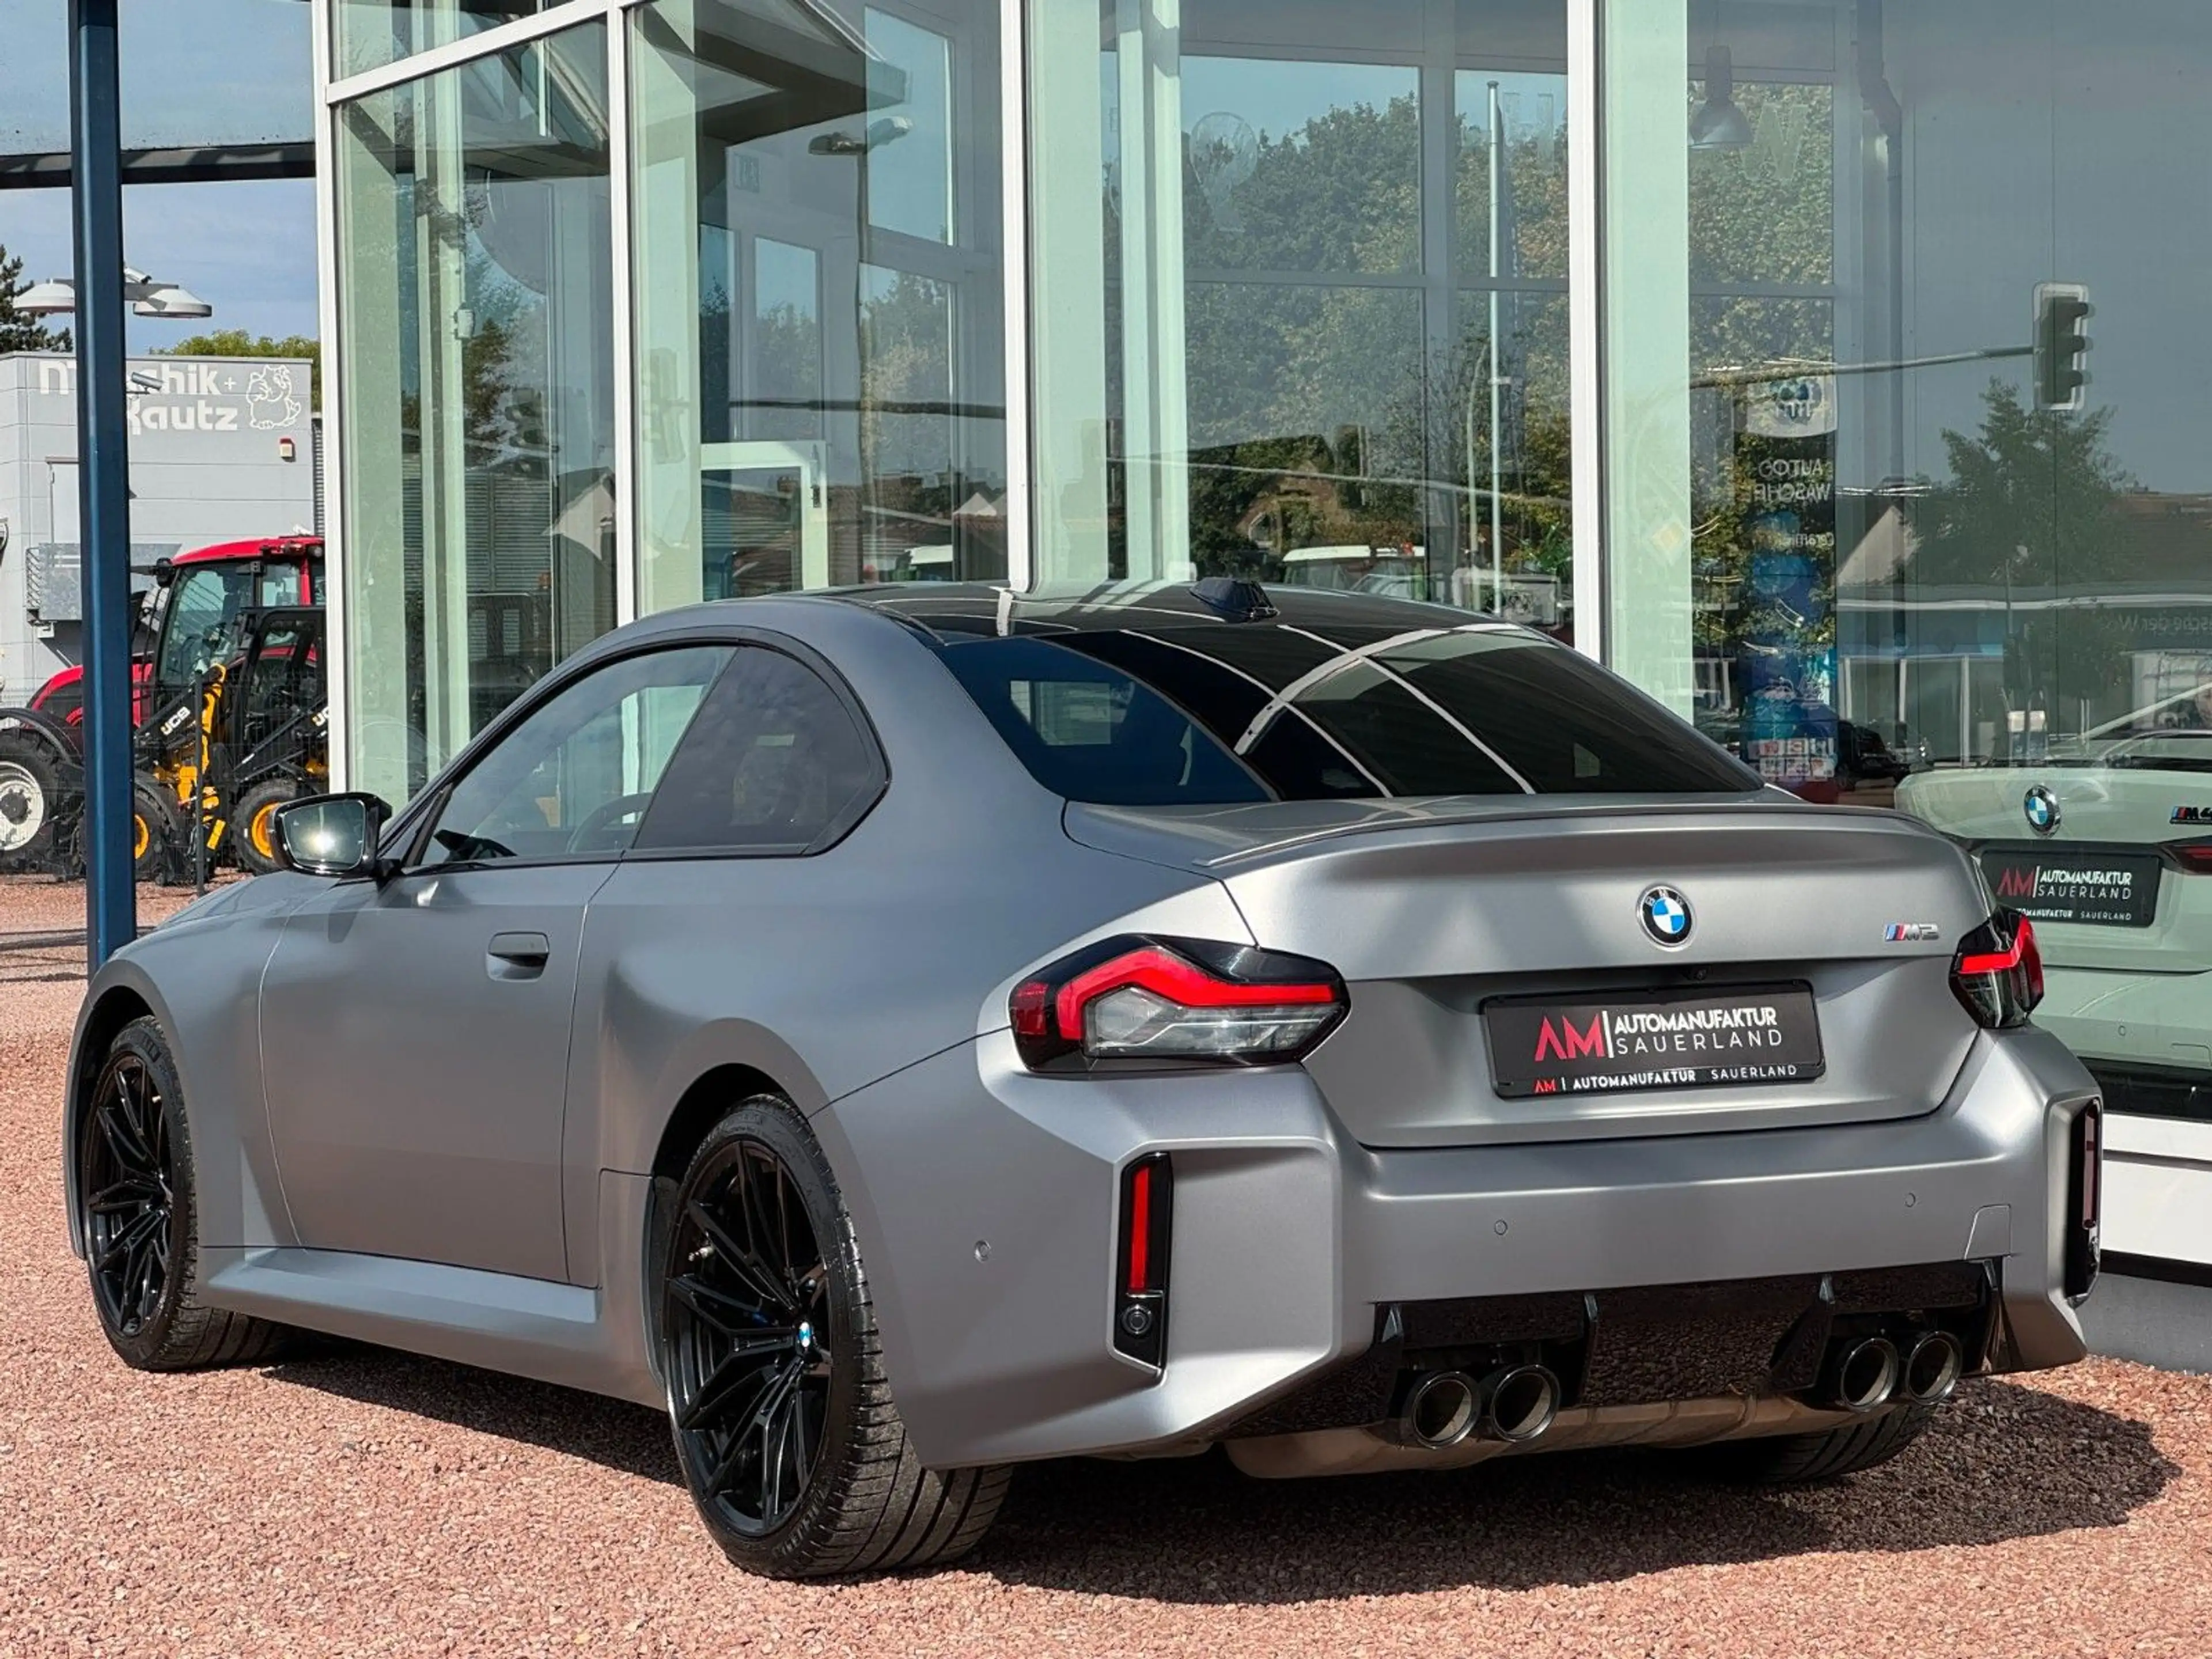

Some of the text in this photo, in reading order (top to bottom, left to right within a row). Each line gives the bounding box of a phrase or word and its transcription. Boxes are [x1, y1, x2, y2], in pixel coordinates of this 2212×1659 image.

[160, 706, 191, 736] JCB
[1997, 868, 2035, 897] AM
[2040, 869, 2132, 886] AUTOMANUFAKTUR
[2037, 884, 2131, 900] SAUERLAND
[2080, 910, 2131, 921] SAUERLAND
[1903, 923, 1940, 941] M2
[1614, 1006, 1778, 1035] AUTOMANUFAKTUR
[1535, 1013, 1605, 1062] AM
[1616, 1028, 1782, 1055] SAUERLAND
[1535, 1064, 1797, 1093] AM AUTOMANUFAKTUR SAUERLAND
